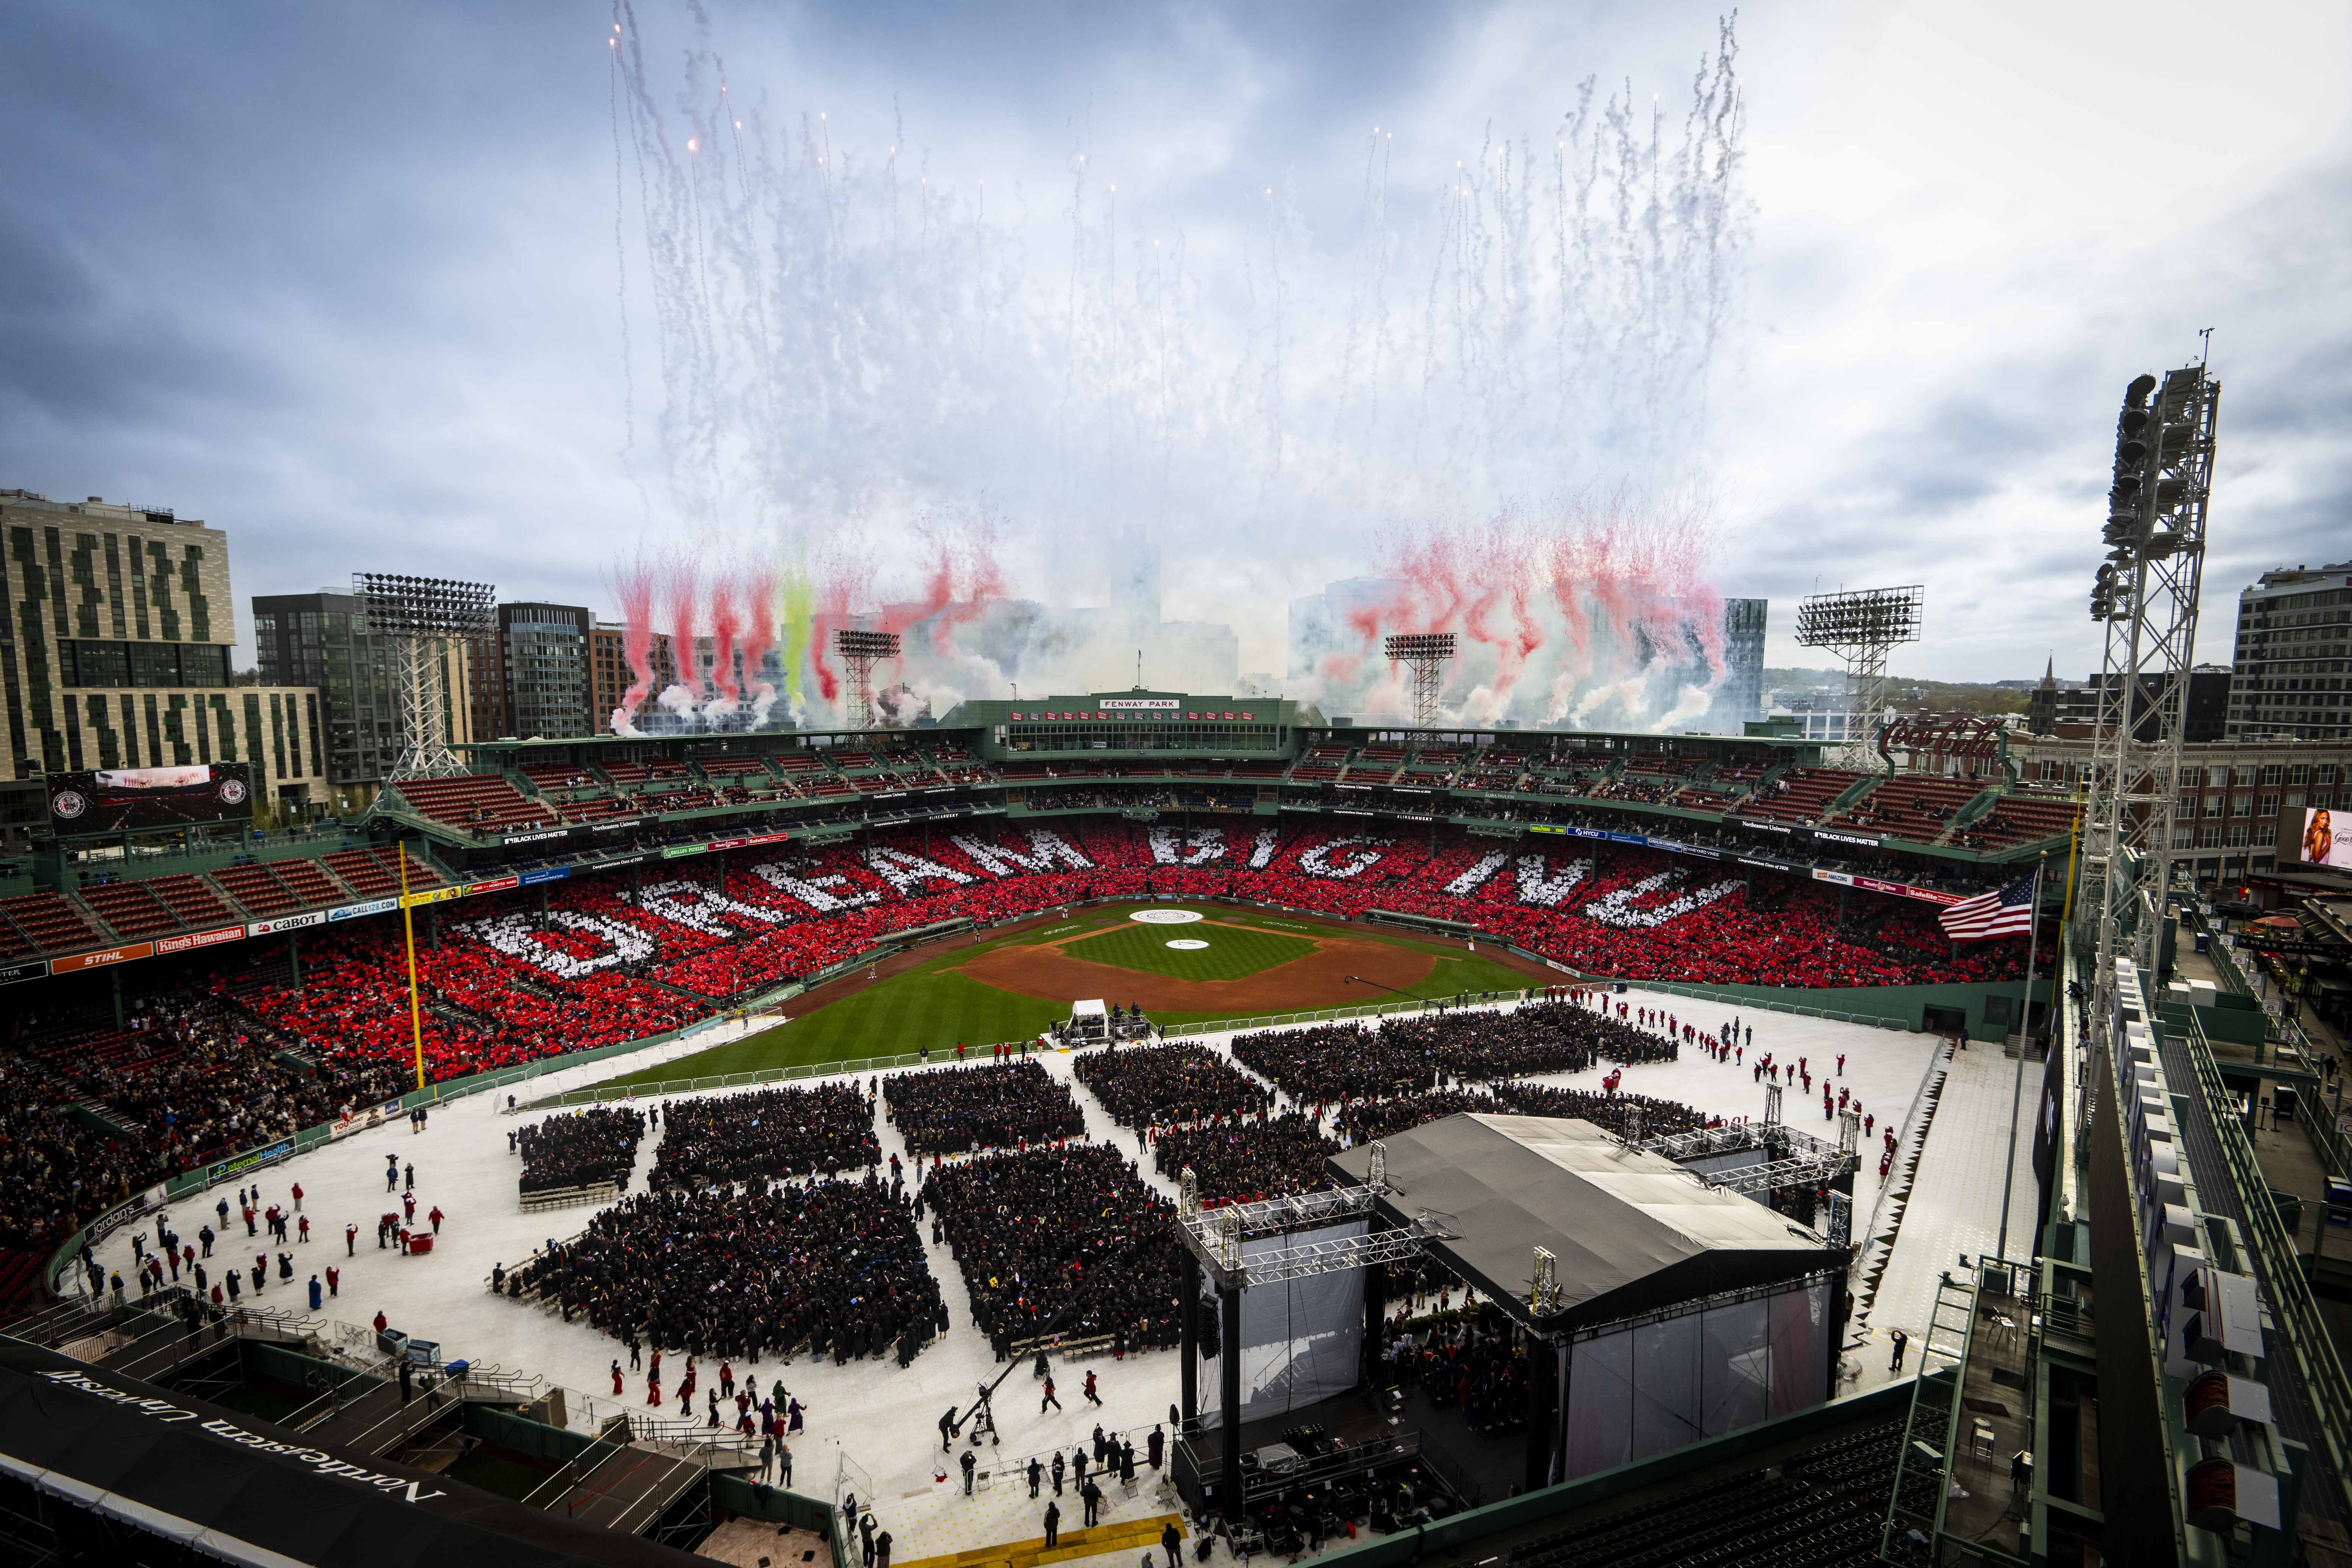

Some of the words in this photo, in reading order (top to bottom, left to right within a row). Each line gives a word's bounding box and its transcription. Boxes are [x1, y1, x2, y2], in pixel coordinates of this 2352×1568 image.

[592, 824, 619, 832] Northeastern
[620, 820, 640, 829] University
[1742, 821, 1768, 830] Northeastern
[1769, 825, 1791, 834] University
[513, 835, 532, 844] BLACK
[548, 830, 568, 840] MATTER
[1822, 832, 1840, 841] BLACK
[1856, 837, 1878, 846] MATTER
[1149, 825, 1397, 878] BIG
[1738, 857, 1764, 866] Congratulations
[1828, 874, 1847, 882] AMAZING
[1910, 890, 1938, 900] Safelite
[352, 900, 396, 915] CALL128.COM
[1043, 925, 1082, 935] WHOOP
[159, 937, 192, 952] King's
[192, 928, 242, 946] Hawaiian
[84, 951, 124, 965] STIHL
[334, 1121, 349, 1131] YOU
[227, 1142, 290, 1172] eternalHealth
[94, 1204, 135, 1236] jordan's
[34, 1370, 198, 1422] University
[201, 1418, 447, 1503] Northeastern
